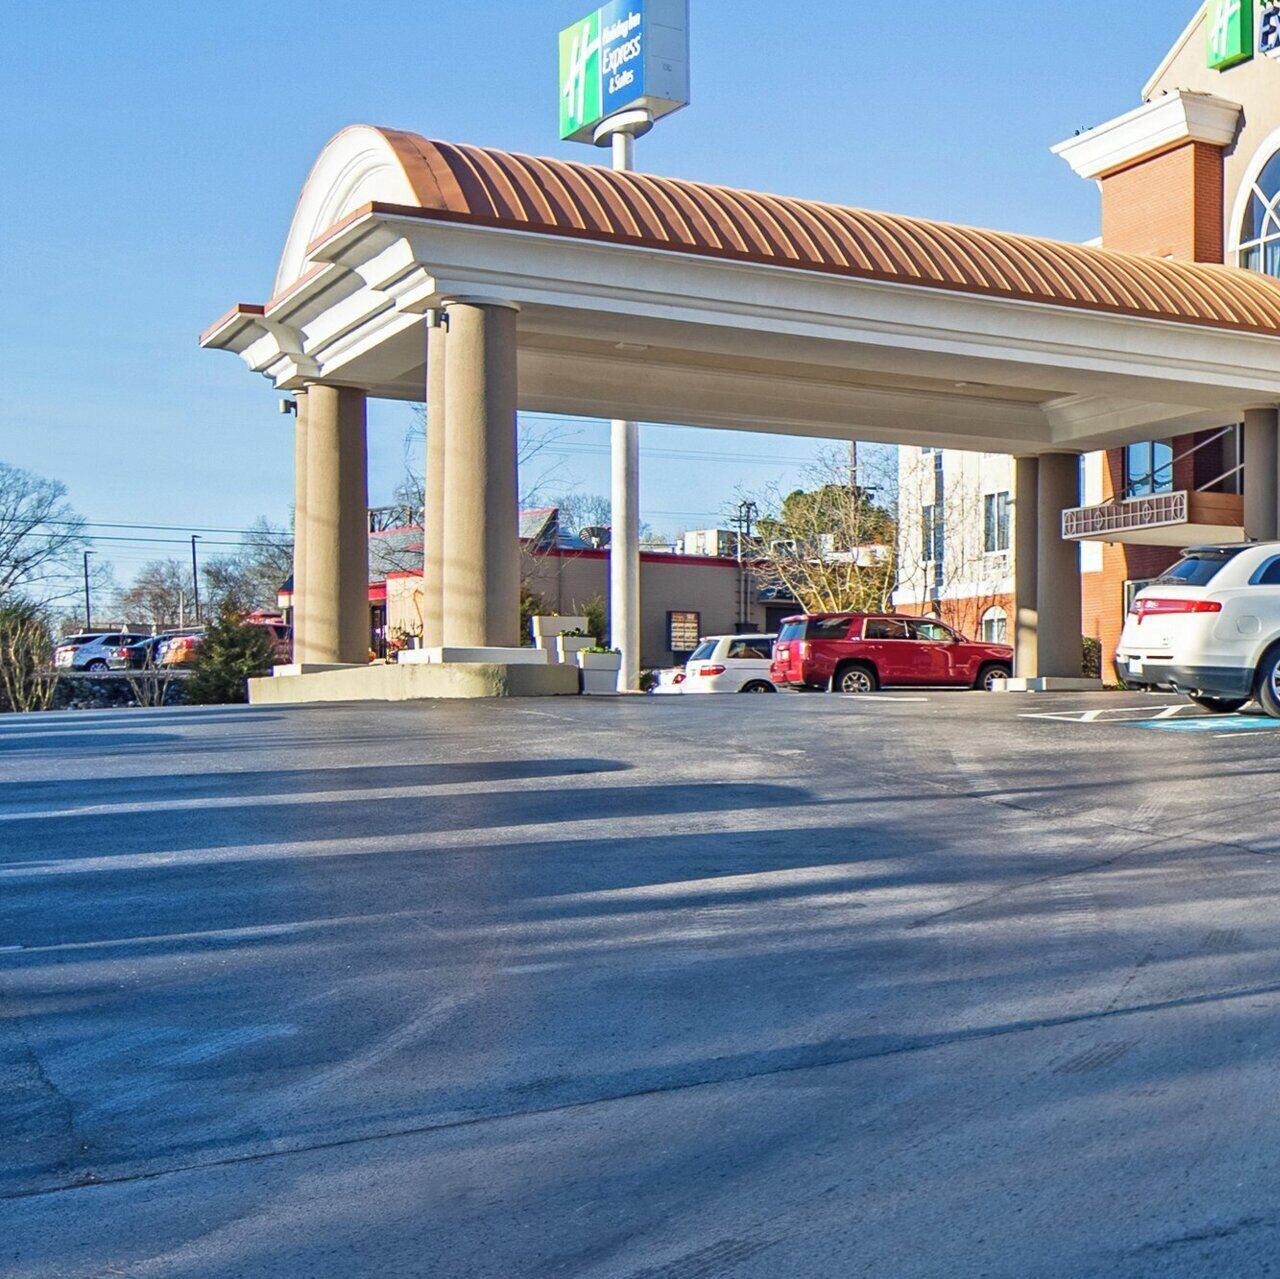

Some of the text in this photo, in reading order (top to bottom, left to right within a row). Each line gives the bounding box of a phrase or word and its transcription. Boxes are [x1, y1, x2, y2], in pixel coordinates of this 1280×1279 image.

[602, 20, 628, 45] Holiday
[602, 35, 641, 75] Express
[614, 69, 634, 91] Suites
